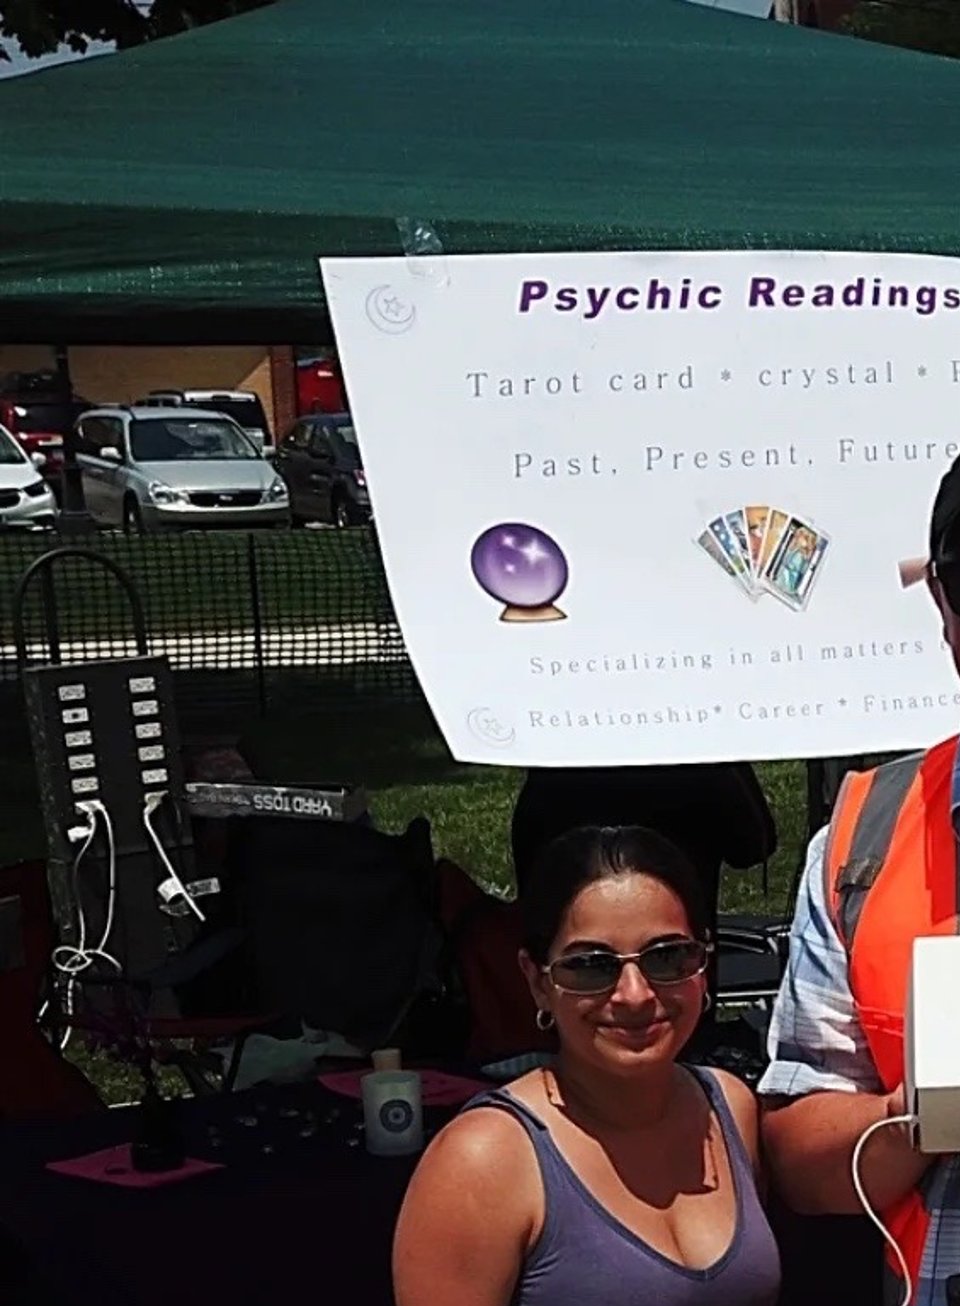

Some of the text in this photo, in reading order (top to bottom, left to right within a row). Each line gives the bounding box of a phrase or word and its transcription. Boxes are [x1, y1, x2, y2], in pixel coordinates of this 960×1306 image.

[519, 279, 723, 319] Psychic
[466, 372, 583, 397] Tarot
[609, 365, 694, 392] card
[759, 361, 893, 388] crystal
[839, 439, 958, 462] Future
[529, 650, 713, 676] Specializing
[730, 648, 752, 665] in
[770, 644, 804, 663] all
[821, 640, 924, 660] matters
[739, 702, 824, 721] Career
[253, 793, 291, 812] TOSS
[293, 797, 333, 817] YARD
